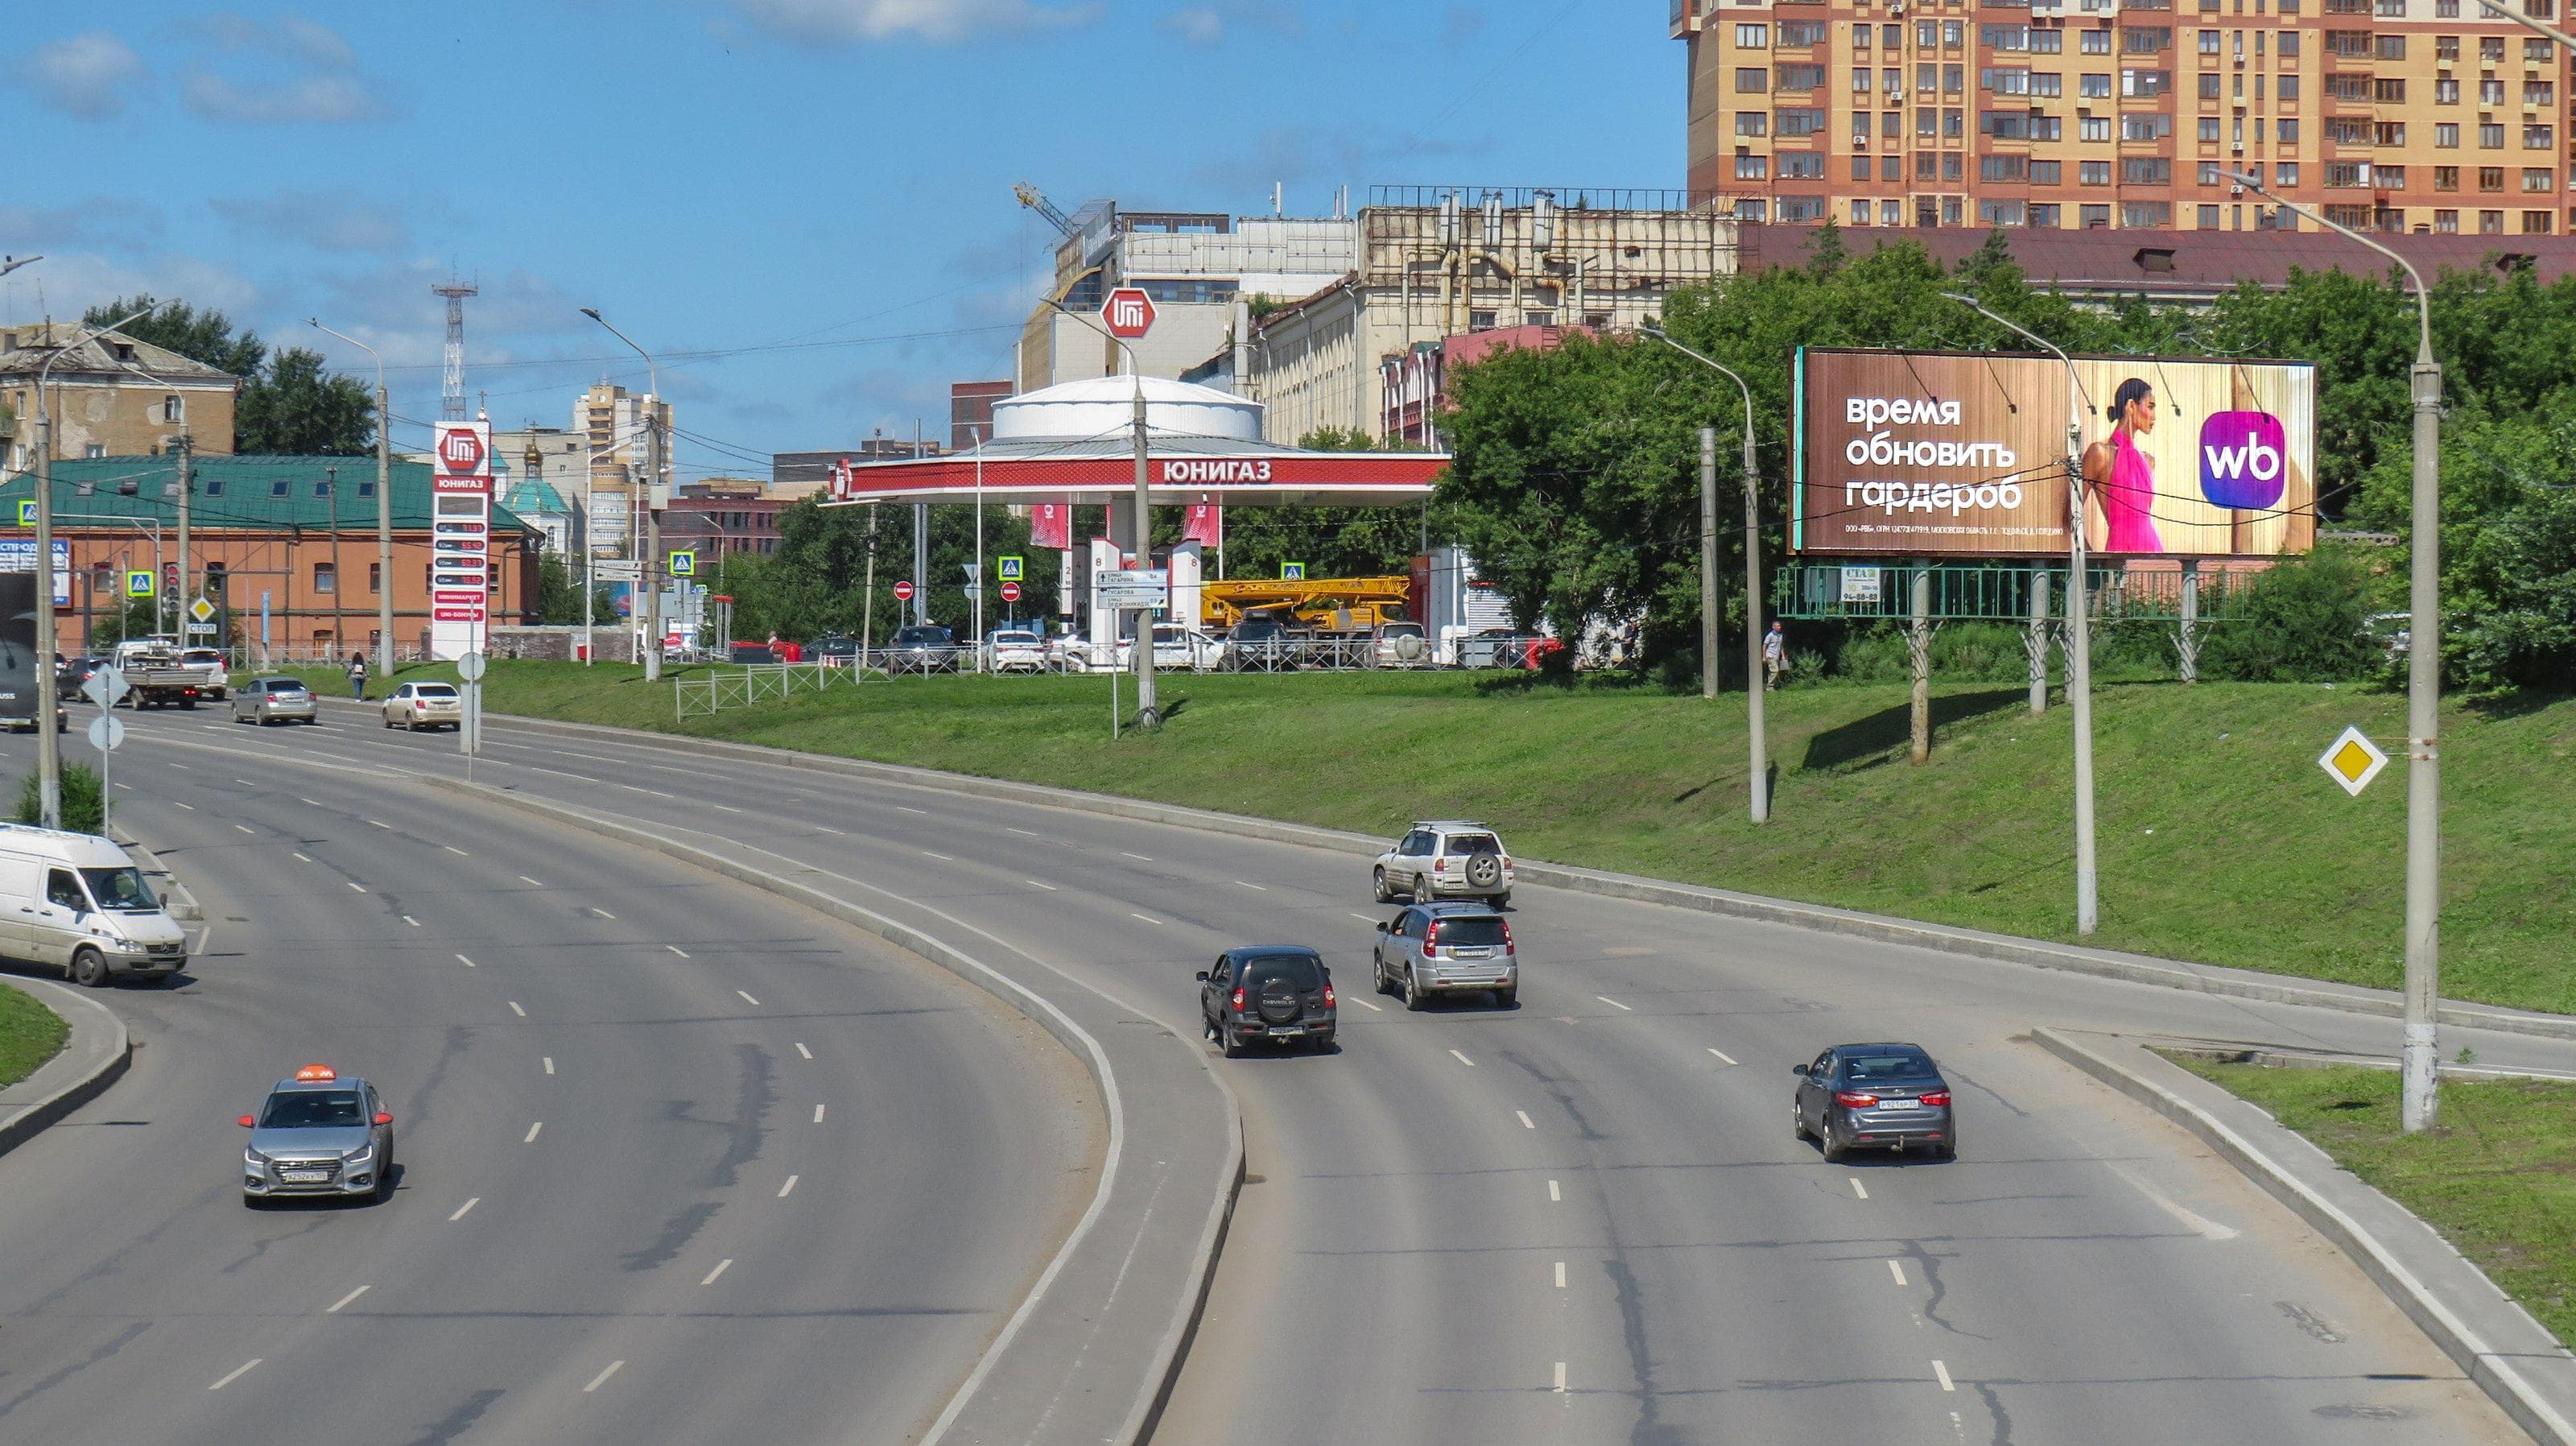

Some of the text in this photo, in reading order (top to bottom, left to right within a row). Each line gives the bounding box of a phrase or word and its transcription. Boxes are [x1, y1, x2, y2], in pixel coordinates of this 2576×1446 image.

[1114, 297, 1143, 328] Uni
[1847, 398, 1961, 432] время
[447, 434, 475, 461] Uni
[1846, 430, 2016, 467] обновить
[2204, 432, 2280, 481] wb
[1164, 461, 1271, 481] ЮНИГАЗ
[438, 479, 484, 489] ЮНИГАЗ
[1846, 475, 2022, 516] гардероб
[1, 543, 65, 553] СПРОДА
[1065, 567, 1071, 575] 2
[1096, 558, 1102, 566] 8
[1191, 558, 1198, 567] 8
[191, 625, 214, 633] СТОП
